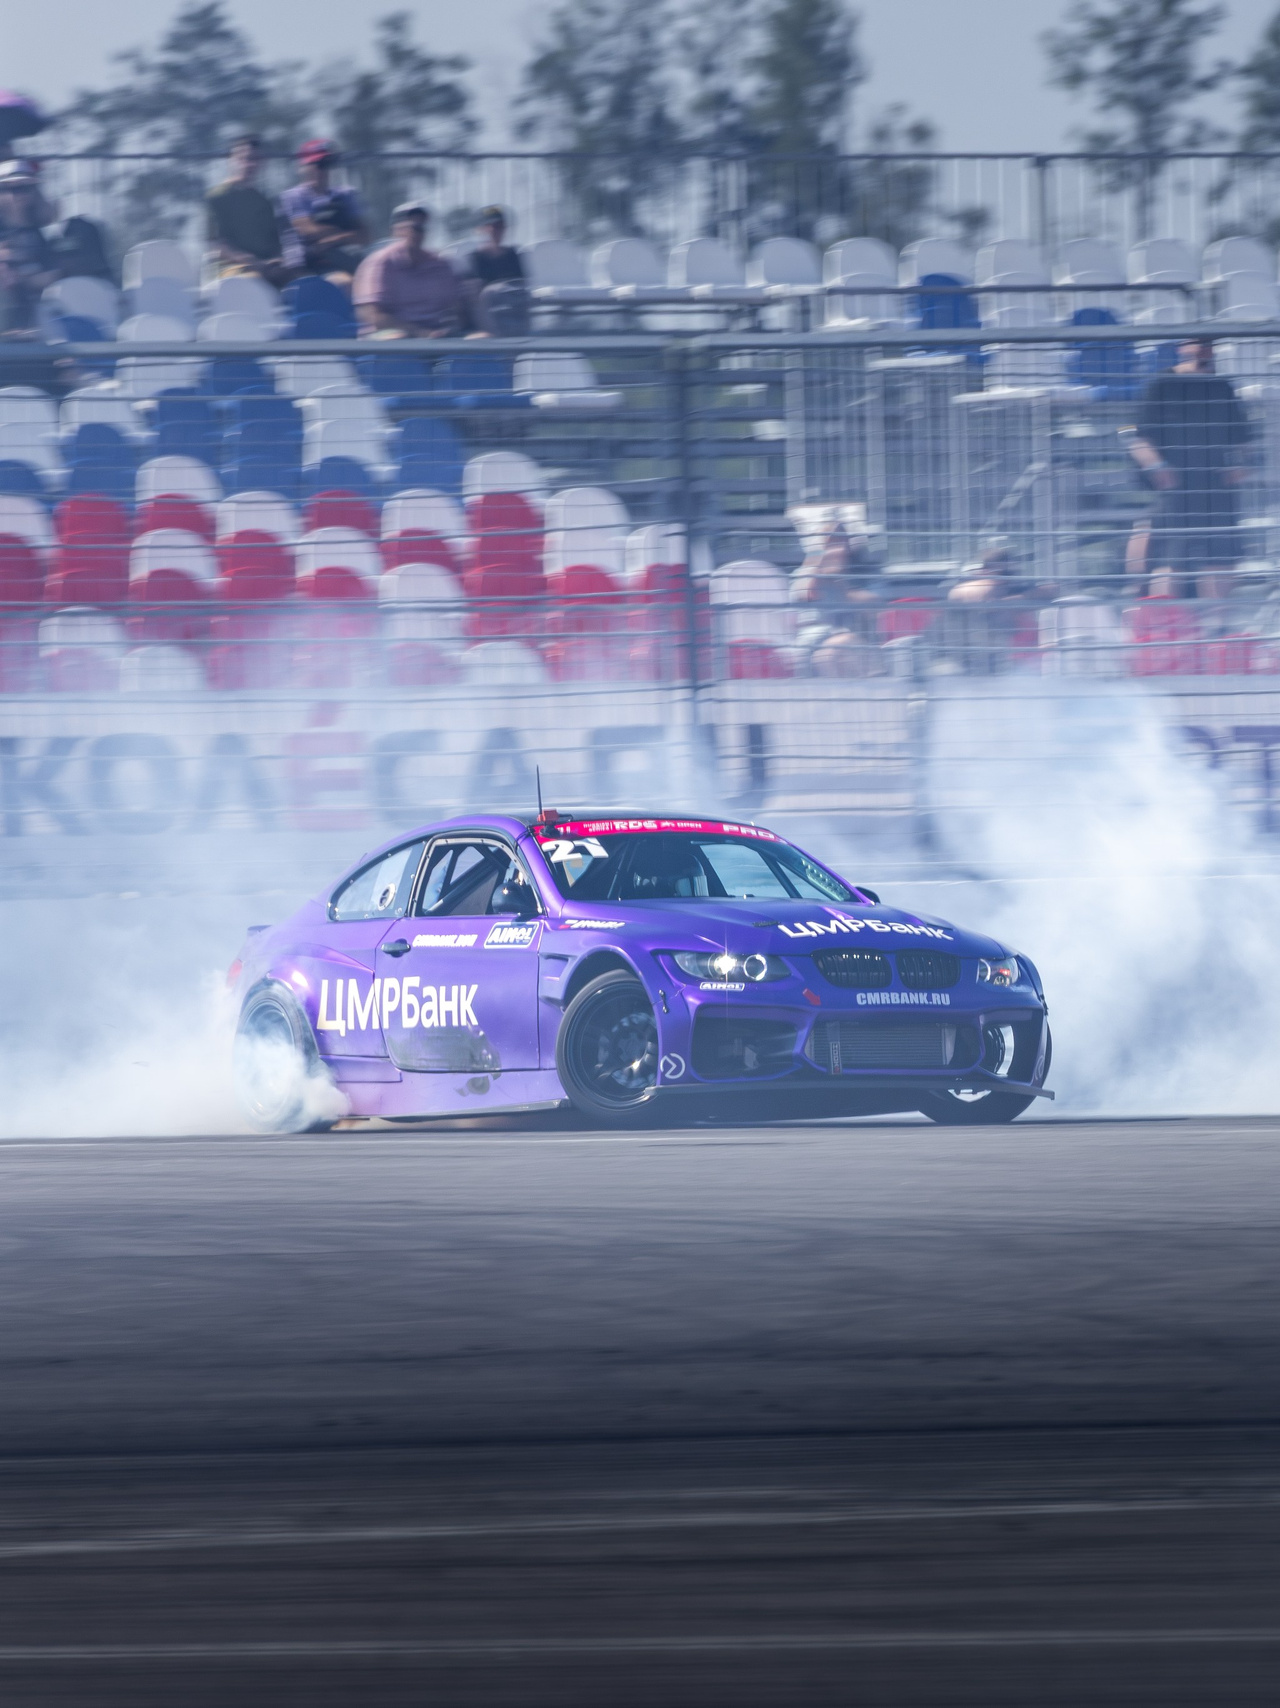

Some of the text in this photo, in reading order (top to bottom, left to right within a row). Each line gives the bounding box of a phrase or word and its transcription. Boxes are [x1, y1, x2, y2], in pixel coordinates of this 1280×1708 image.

[614, 820, 658, 831] RDS
[777, 918, 954, 941] ЦМРБанк
[316, 976, 479, 1037] ЦМРБанк
[856, 992, 951, 1006] CMRBANK.RU
